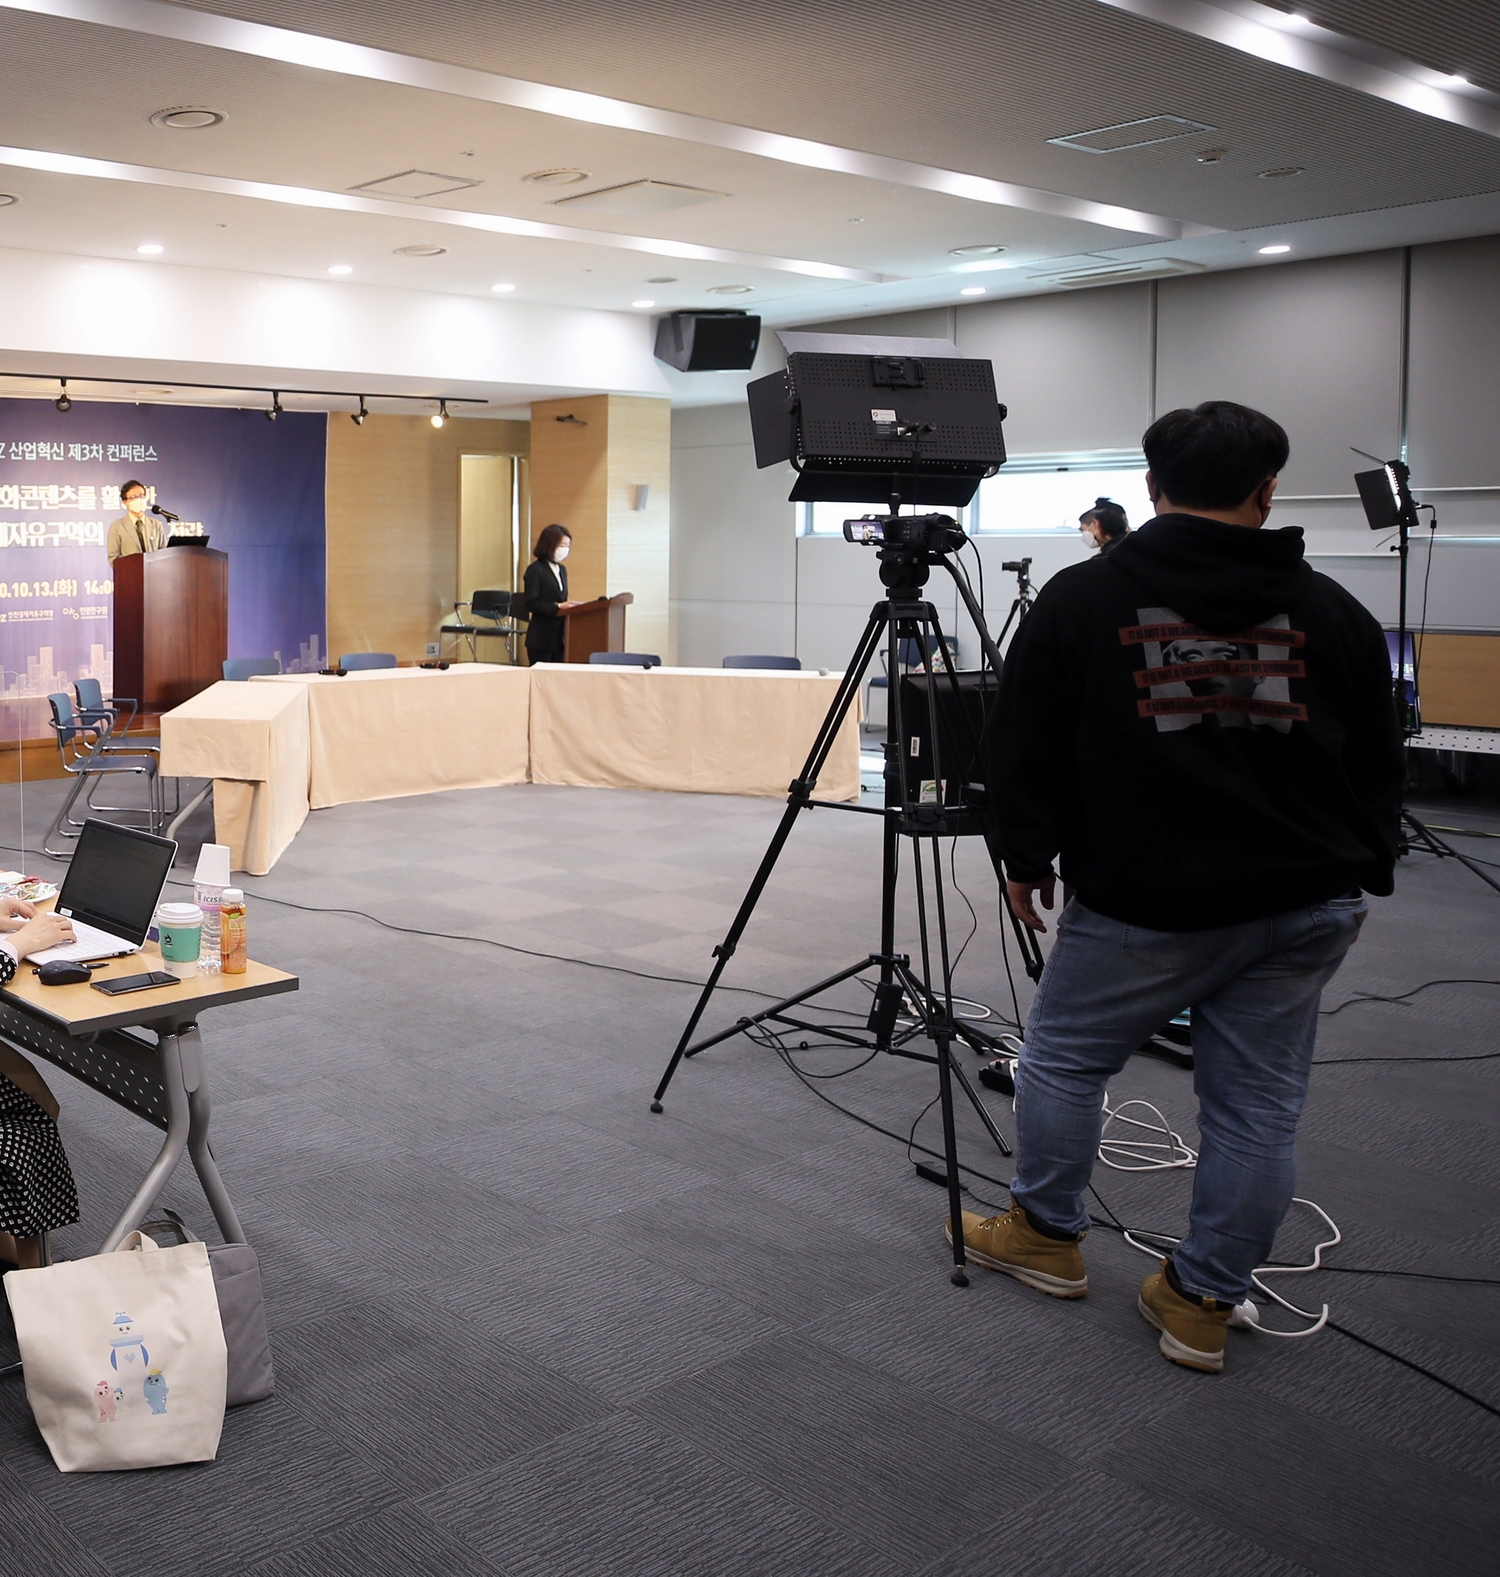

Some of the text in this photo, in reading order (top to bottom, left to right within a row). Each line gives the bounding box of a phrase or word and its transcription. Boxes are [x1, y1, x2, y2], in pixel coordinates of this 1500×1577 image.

[9, 441, 64, 461] 산업혁신
[67, 443, 103, 462] 제3차
[107, 444, 158, 462] 컨퍼런스
[101, 485, 157, 510] 활한
[84, 579, 114, 595] 14:0
